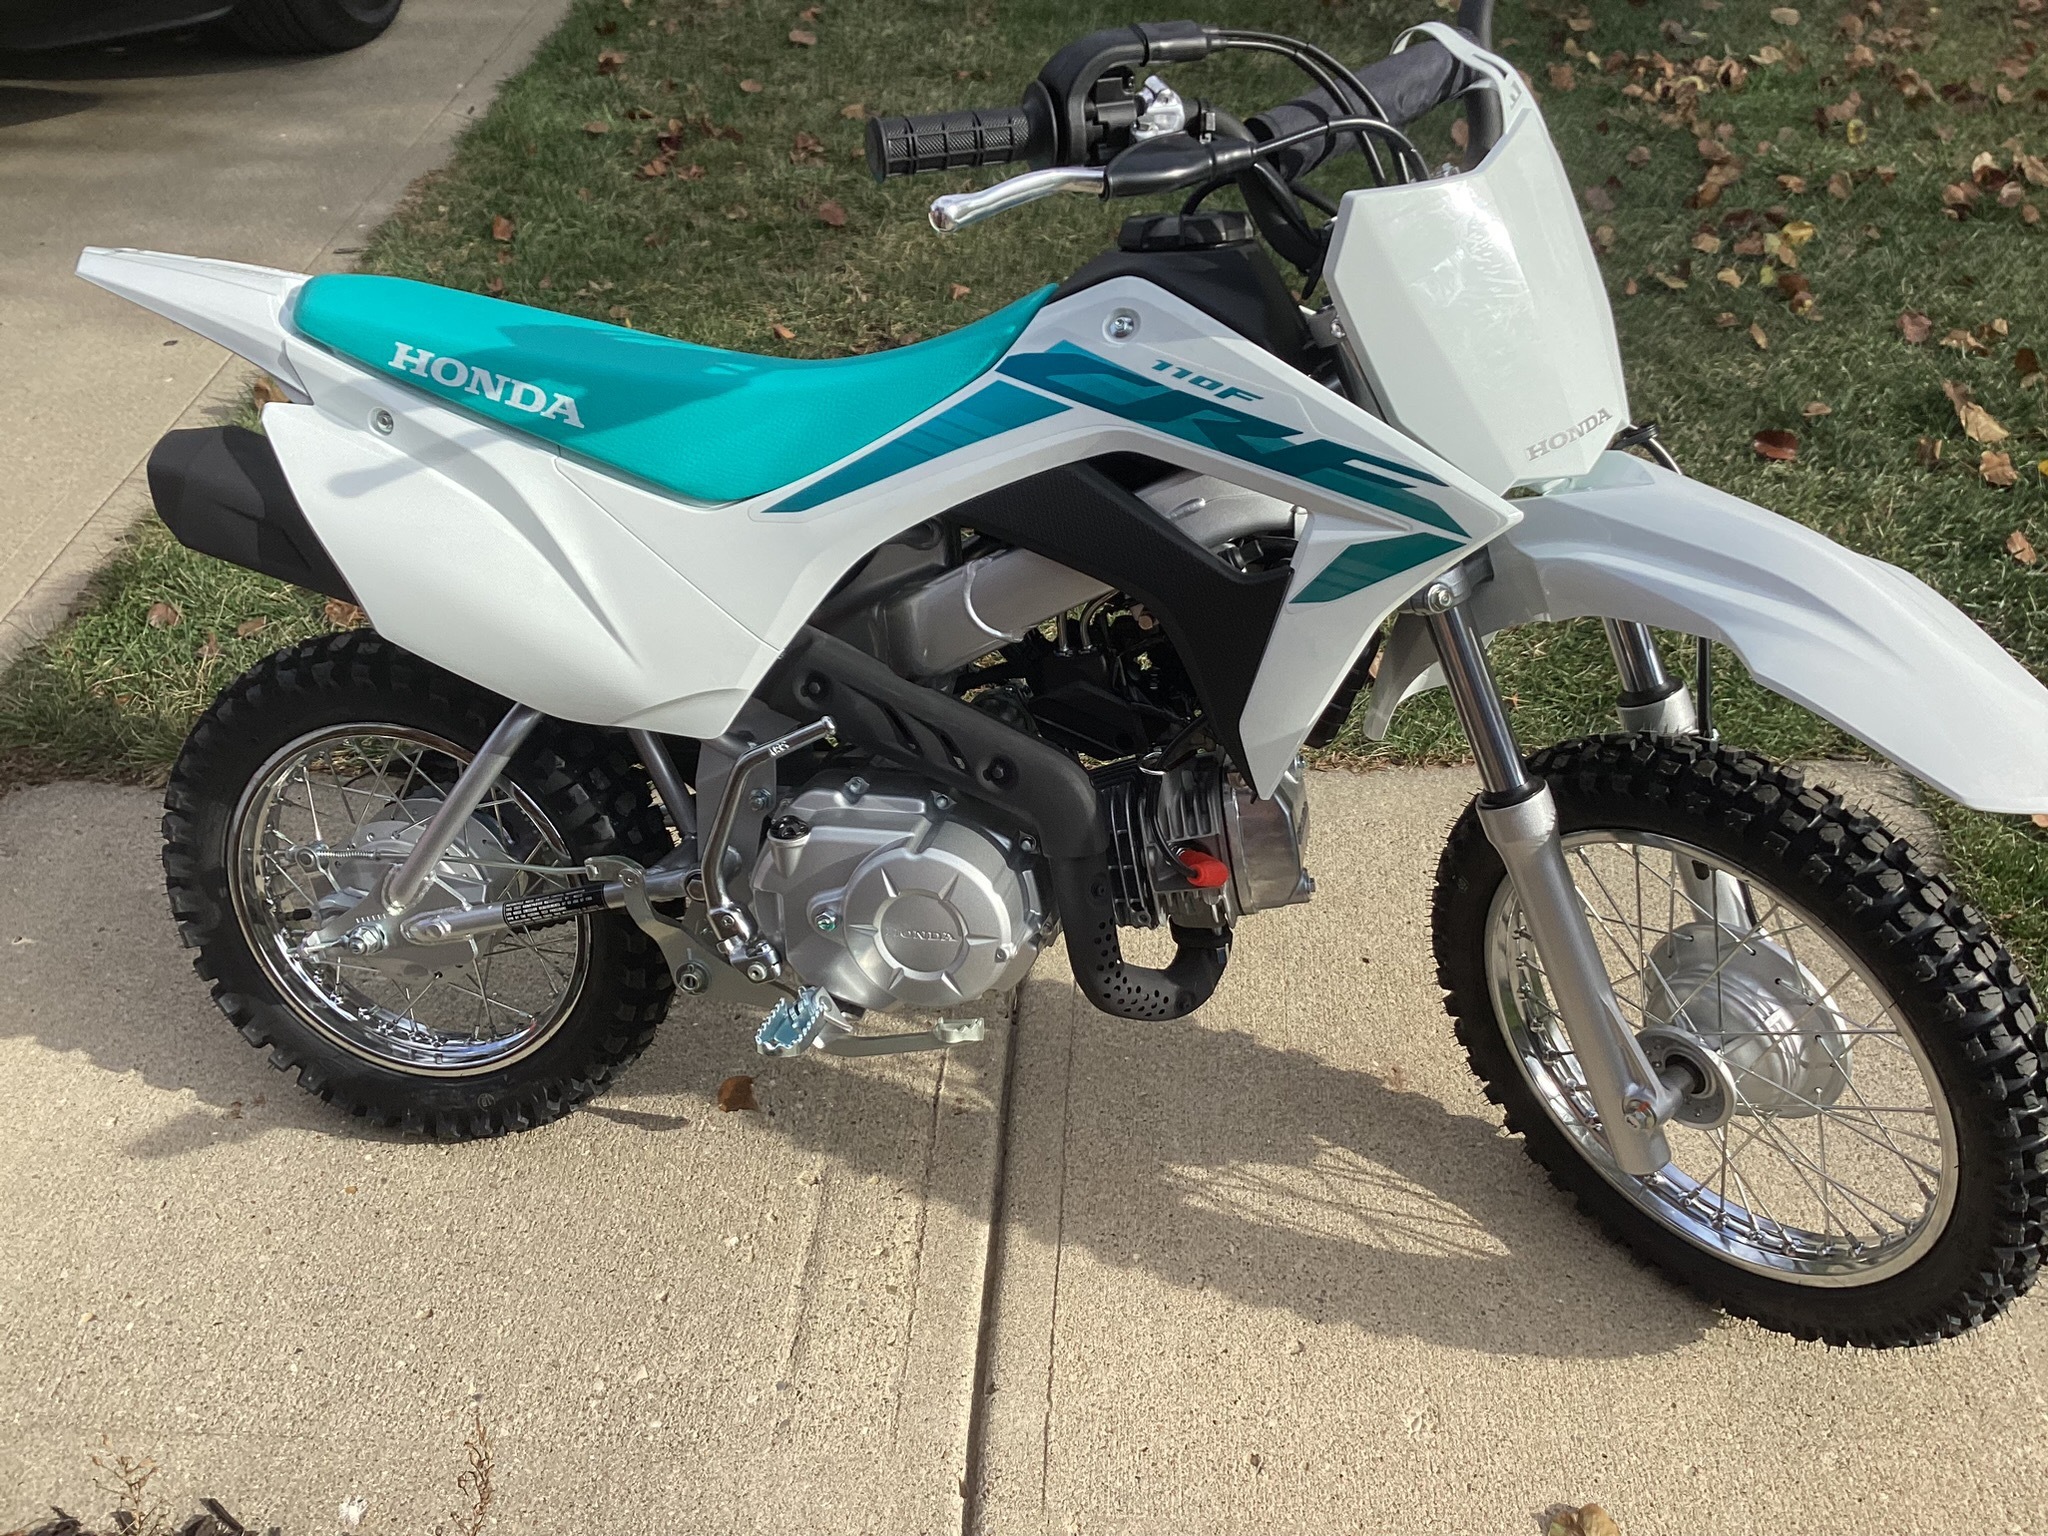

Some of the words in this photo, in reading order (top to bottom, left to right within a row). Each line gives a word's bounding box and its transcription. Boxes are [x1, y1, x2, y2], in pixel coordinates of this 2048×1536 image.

[388, 341, 585, 429] HONDA
[1151, 359, 1265, 402] 110F
[1526, 407, 1613, 461] HONDA
